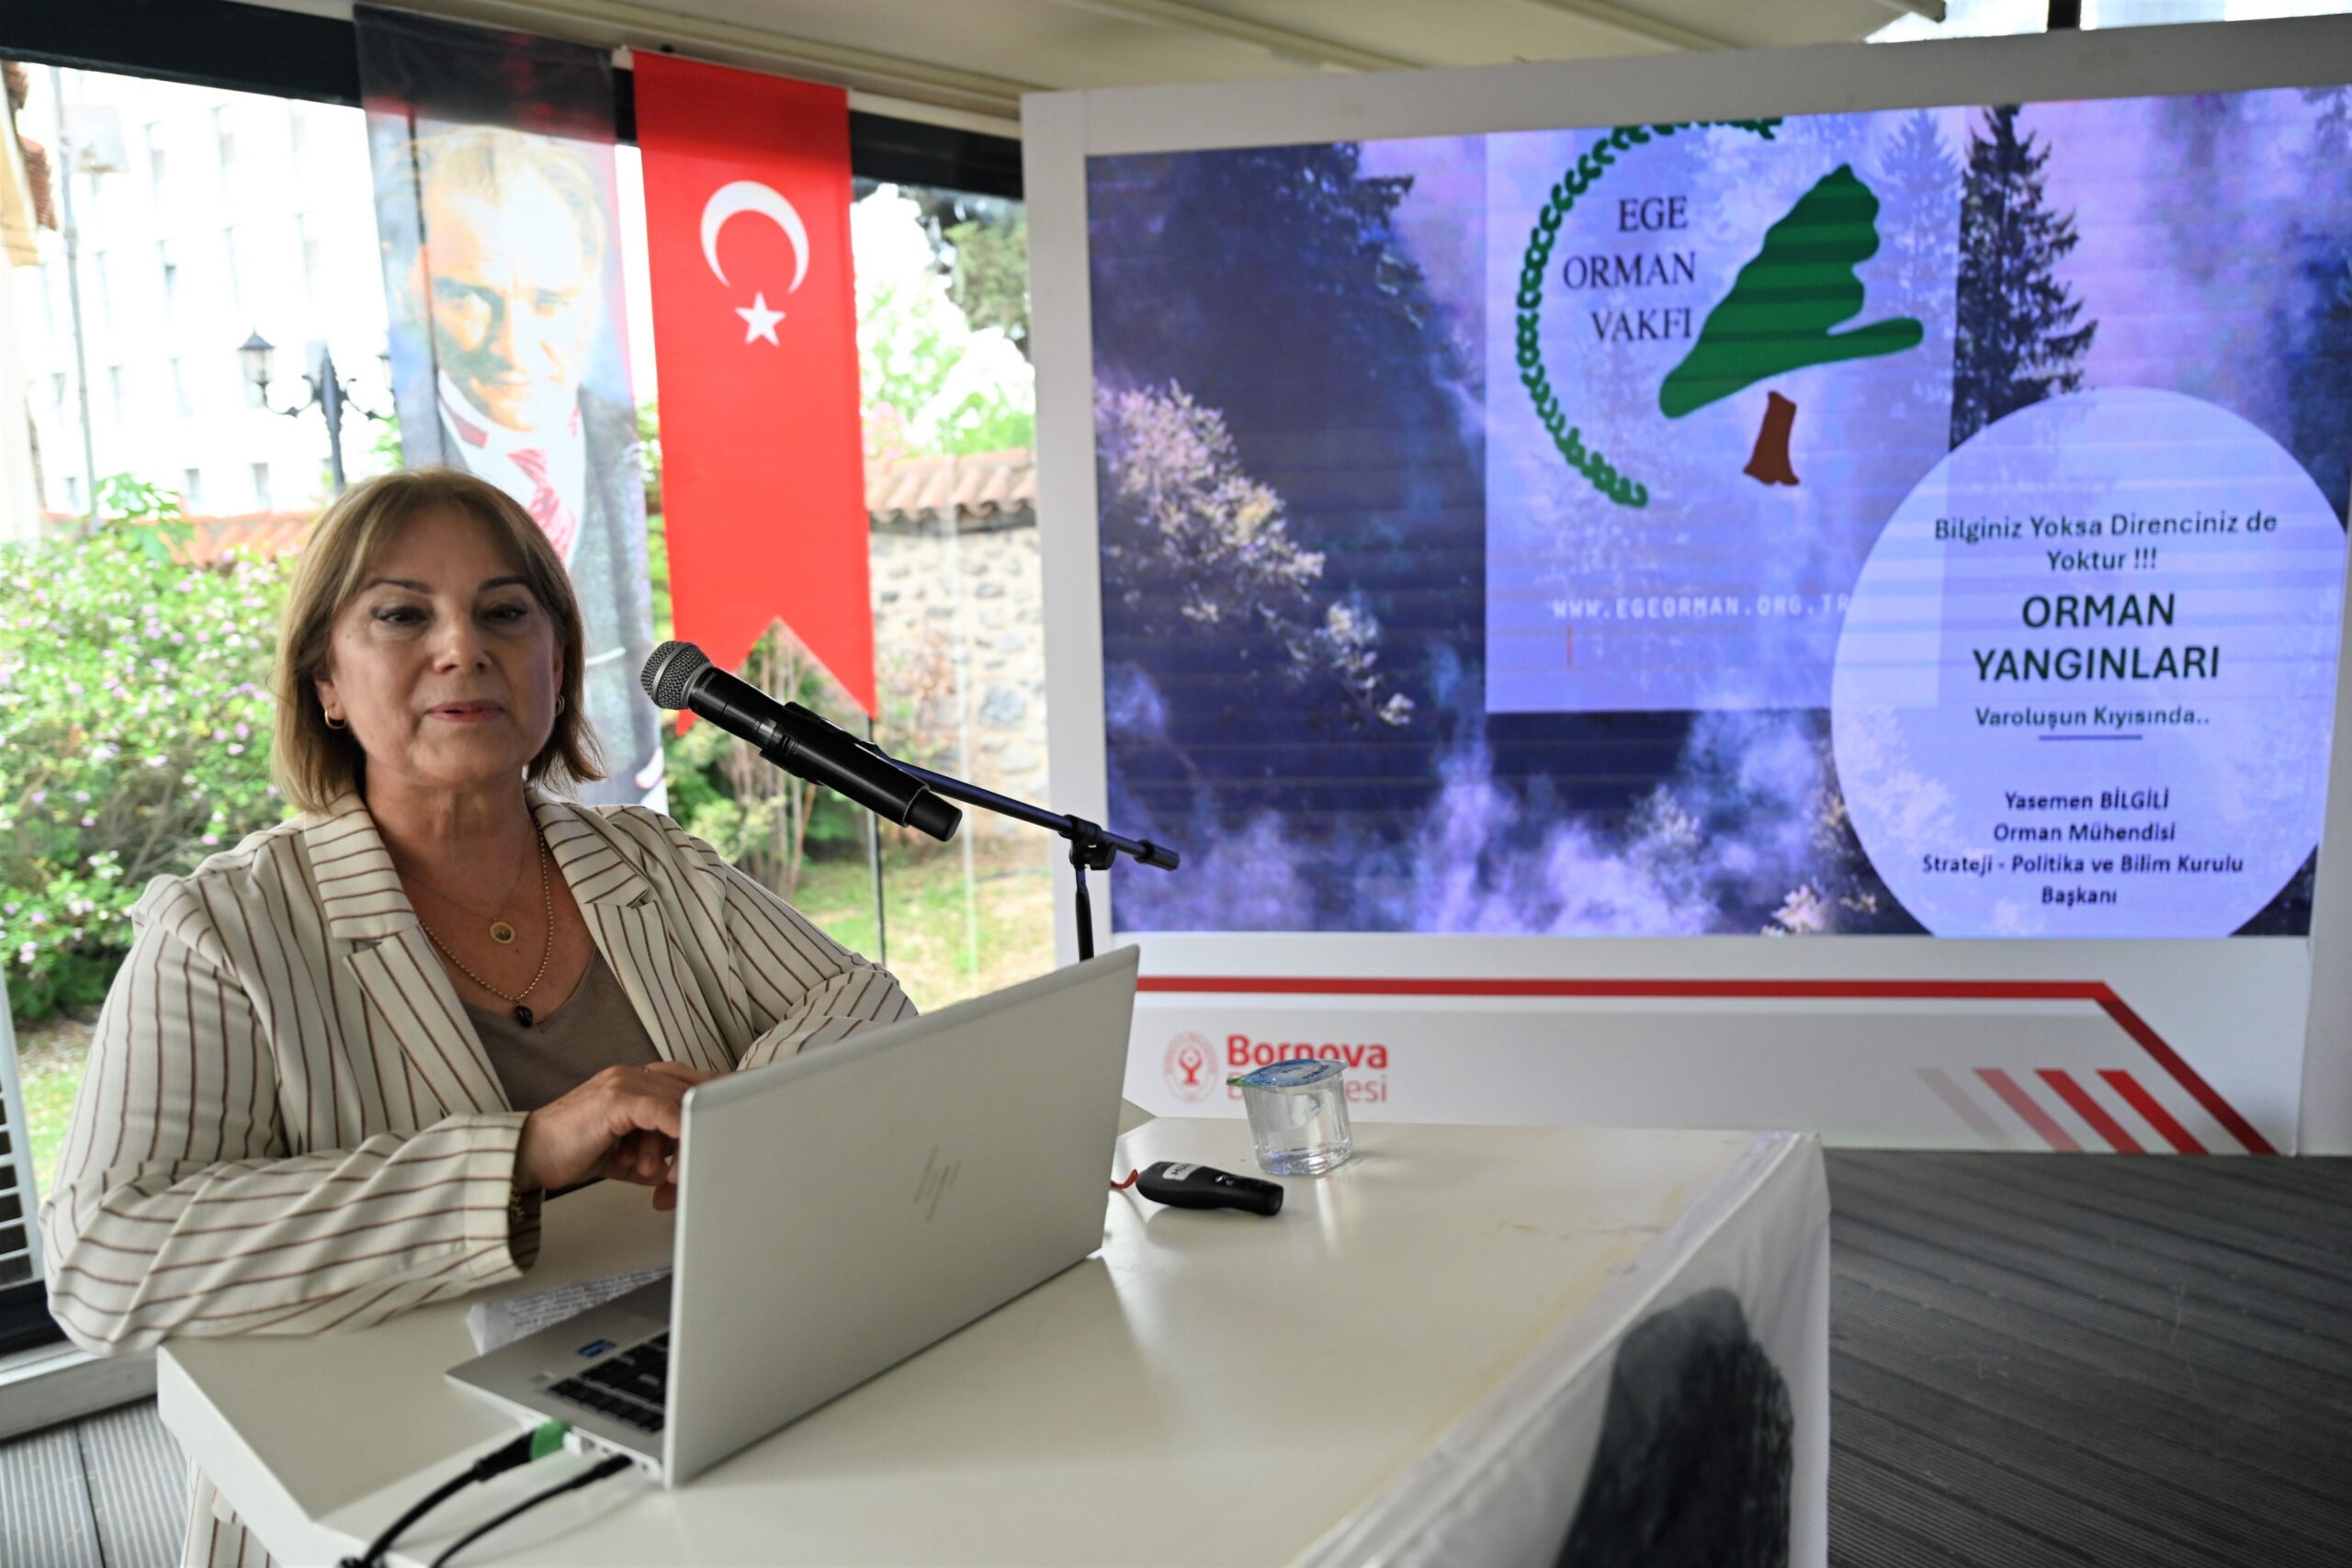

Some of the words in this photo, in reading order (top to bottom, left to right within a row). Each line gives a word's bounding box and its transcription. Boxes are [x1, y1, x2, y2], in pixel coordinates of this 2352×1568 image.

[1619, 195, 1688, 232] EGE
[1563, 251, 1696, 290] ORMAN
[1591, 307, 1691, 342] VAKFI
[1935, 515, 2022, 544] Bilginiz
[2030, 515, 2102, 537] Yoksa
[2111, 510, 2238, 536] Direnciniz
[2246, 510, 2278, 532] de
[2047, 550, 2127, 570] Yoktur
[2133, 547, 2157, 570] !!!
[2022, 593, 2175, 627] ORMAN
[1973, 646, 2220, 681] YANGINLARI
[1975, 707, 2086, 729] Varoluşun
[2005, 792, 2093, 809] Yasemen
[2100, 786, 2169, 809] BİLGİLİ
[1994, 823, 2062, 841] Orman
[2069, 821, 2176, 840] Mühendisi
[1923, 854, 1993, 876] Strateji
[2012, 854, 2084, 872] Politika
[2091, 860, 2113, 872] ve
[2121, 854, 2170, 872] Bilim
[2177, 854, 2244, 872] Kurulu
[2041, 886, 2117, 908] Başkanı
[1227, 1034, 1388, 1068] Bornova
